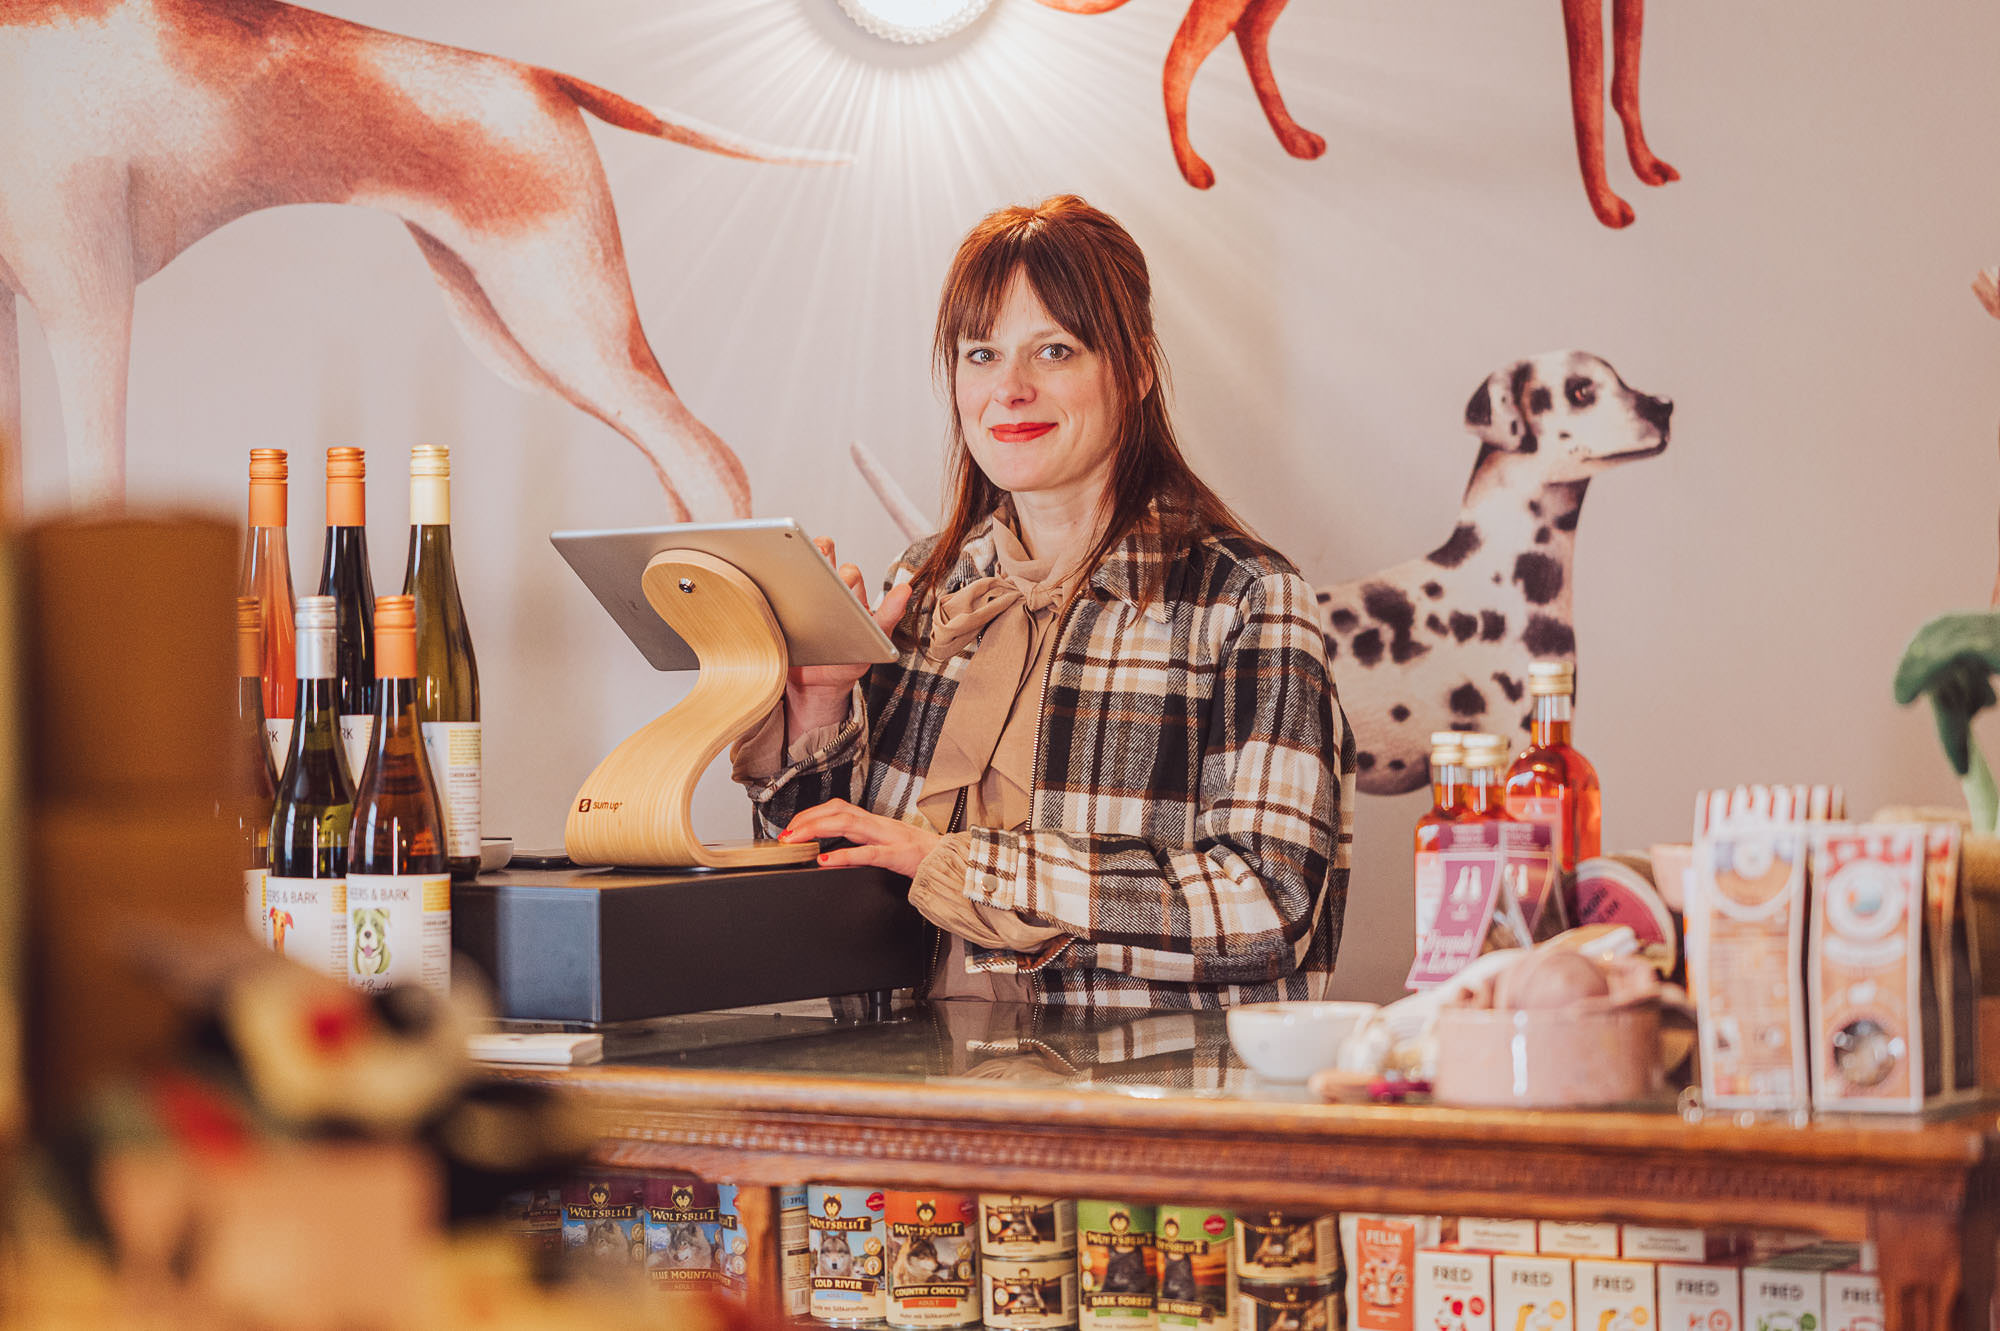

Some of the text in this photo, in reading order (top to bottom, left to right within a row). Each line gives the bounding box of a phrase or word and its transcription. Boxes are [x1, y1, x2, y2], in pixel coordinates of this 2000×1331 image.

[290, 892, 319, 905] BARK
[380, 887, 410, 901] BARK
[569, 1205, 633, 1219] WOLFSBLUT
[652, 1209, 716, 1222] WOLFSBLUT
[809, 1217, 868, 1231] WOLFSBLUT
[1433, 1264, 1472, 1283] FRED
[1512, 1269, 1552, 1287] FRED
[814, 1279, 863, 1290] COLD RIVER
[1593, 1275, 1635, 1293] FRED
[1676, 1279, 1719, 1297] FRED
[1760, 1281, 1804, 1300] FRED
[895, 1287, 965, 1297] COUNTRY CHICKEN
